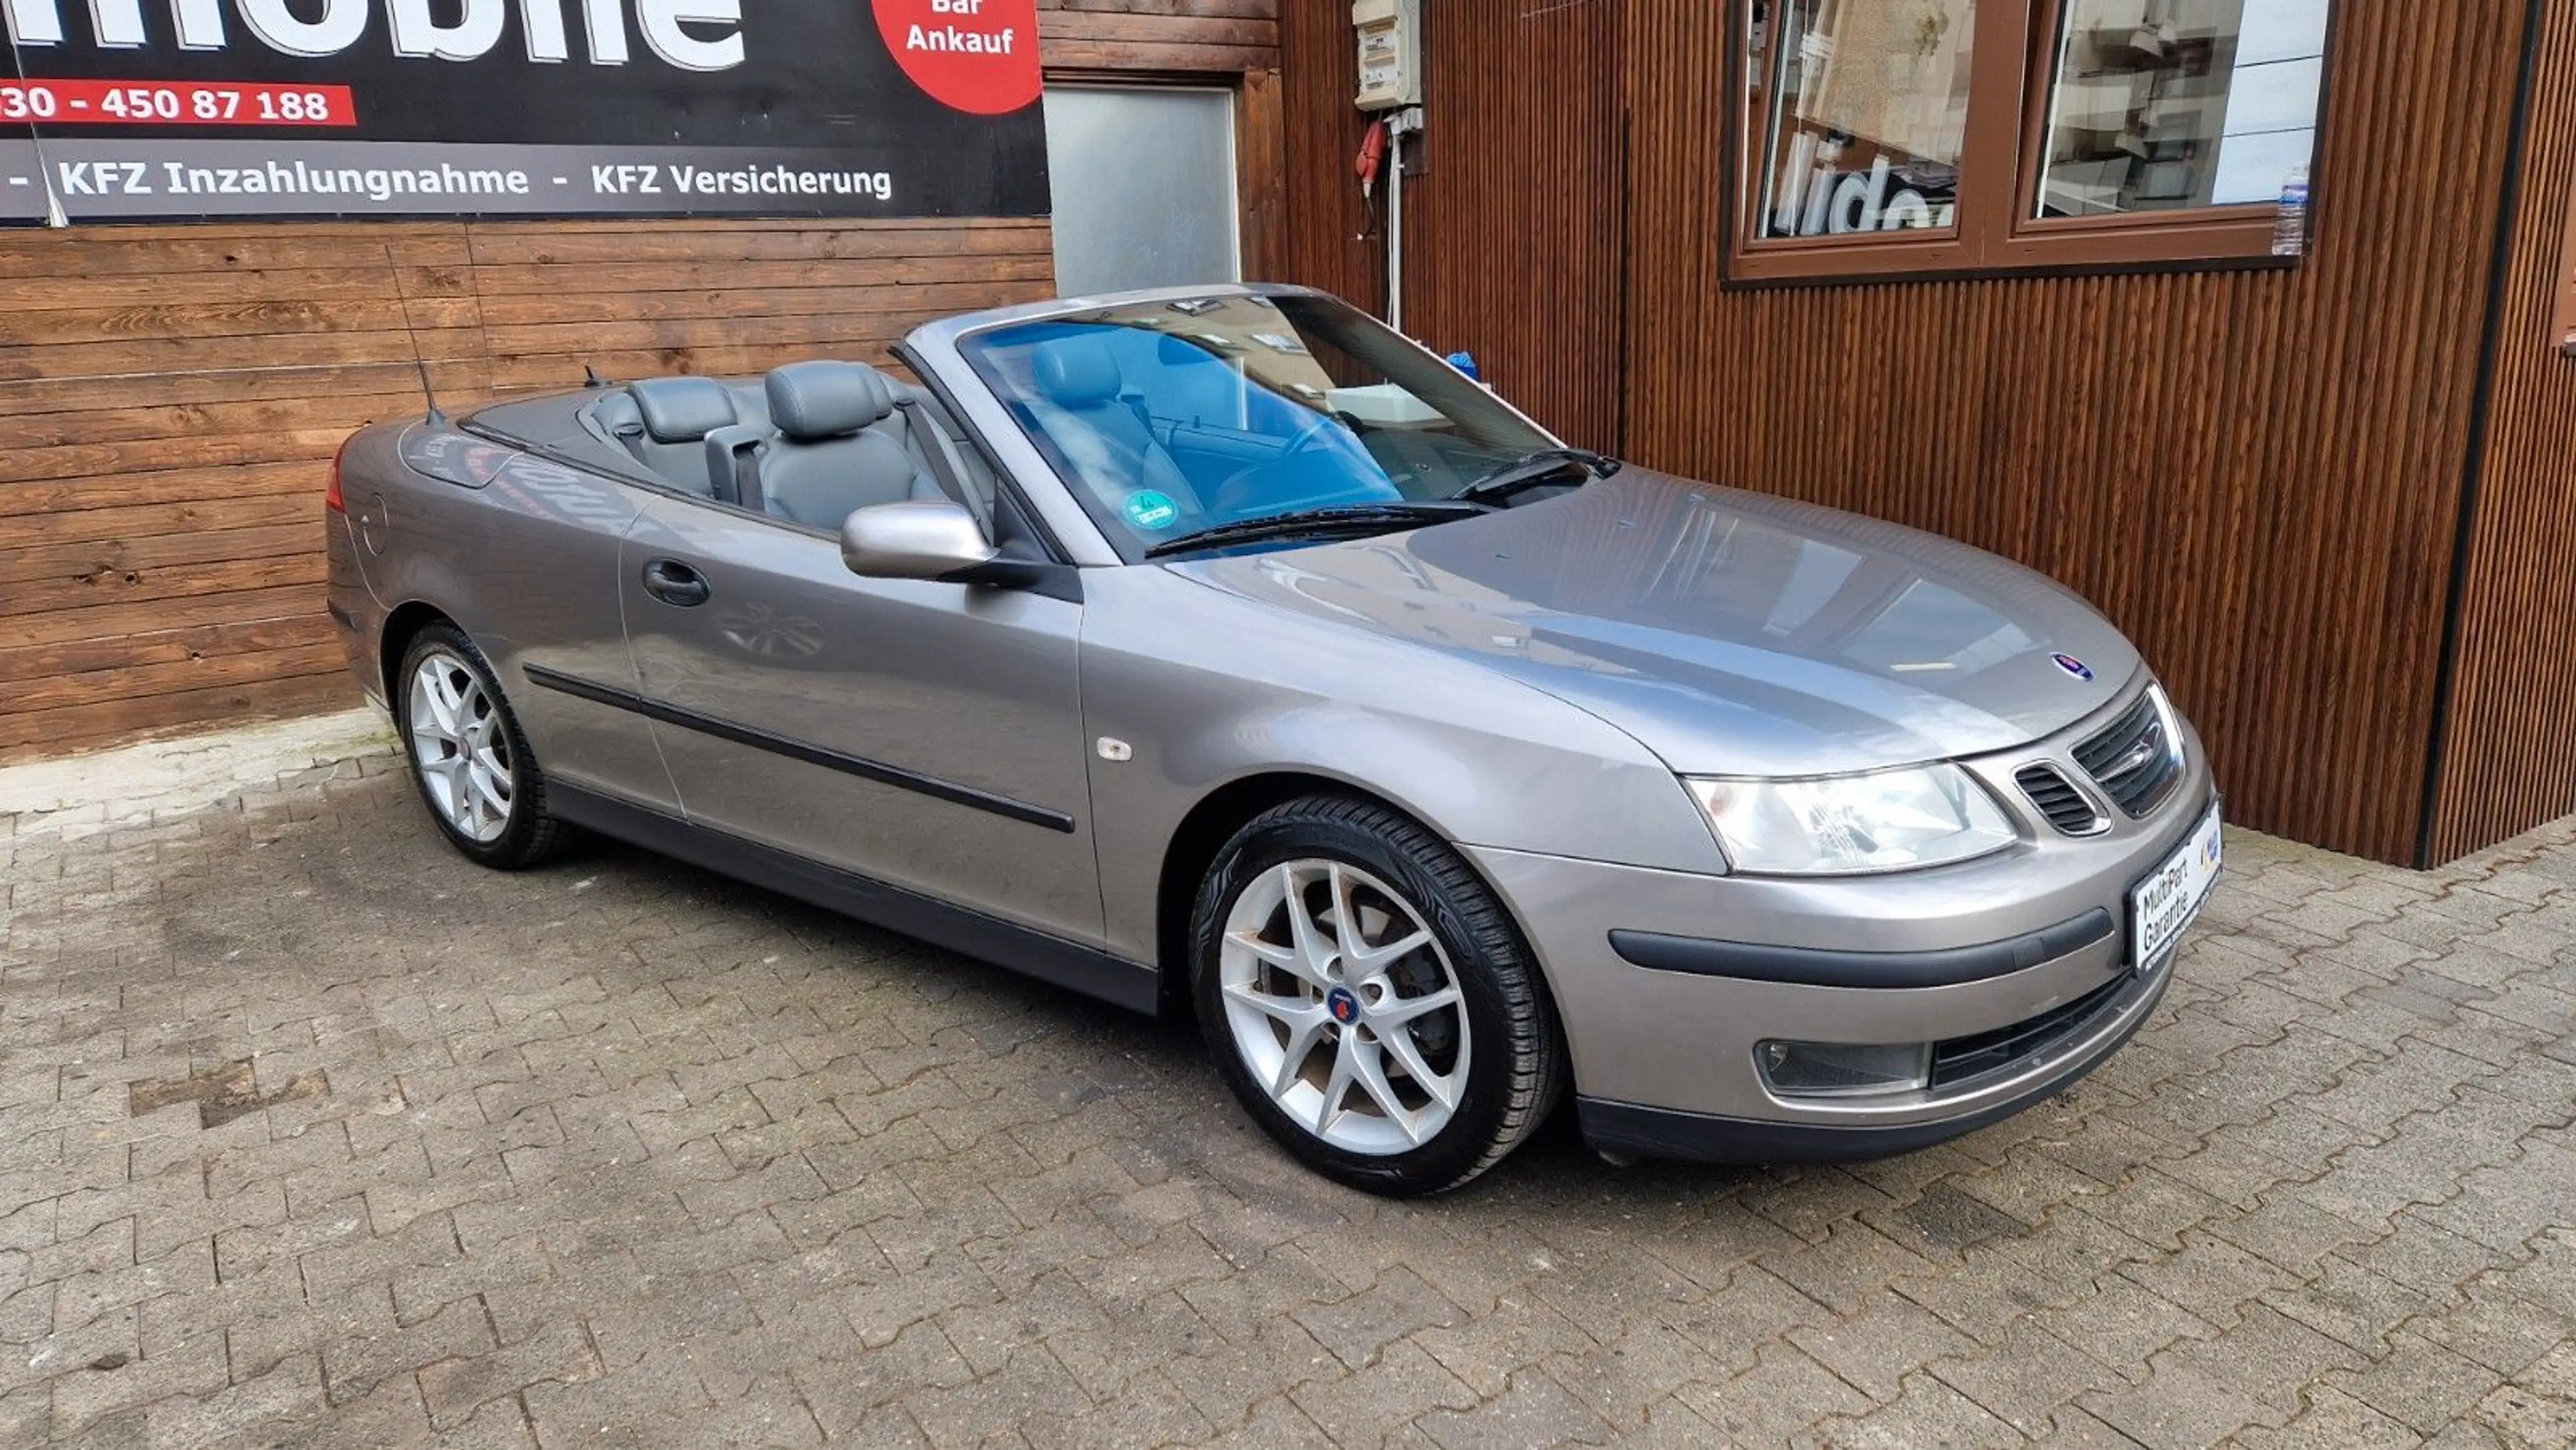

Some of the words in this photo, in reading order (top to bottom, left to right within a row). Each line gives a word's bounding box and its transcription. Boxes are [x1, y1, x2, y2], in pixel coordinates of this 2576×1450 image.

[907, 24, 1014, 54] Ankauf
[101, 89, 180, 119] 450
[191, 90, 240, 119] 87
[256, 92, 328, 120] 188
[59, 162, 152, 194] KFZ
[163, 161, 529, 201] Inzahlungnahme
[592, 165, 661, 194] KFZ
[669, 165, 892, 200] Versicherung
[2143, 890, 2190, 951] Garantie
